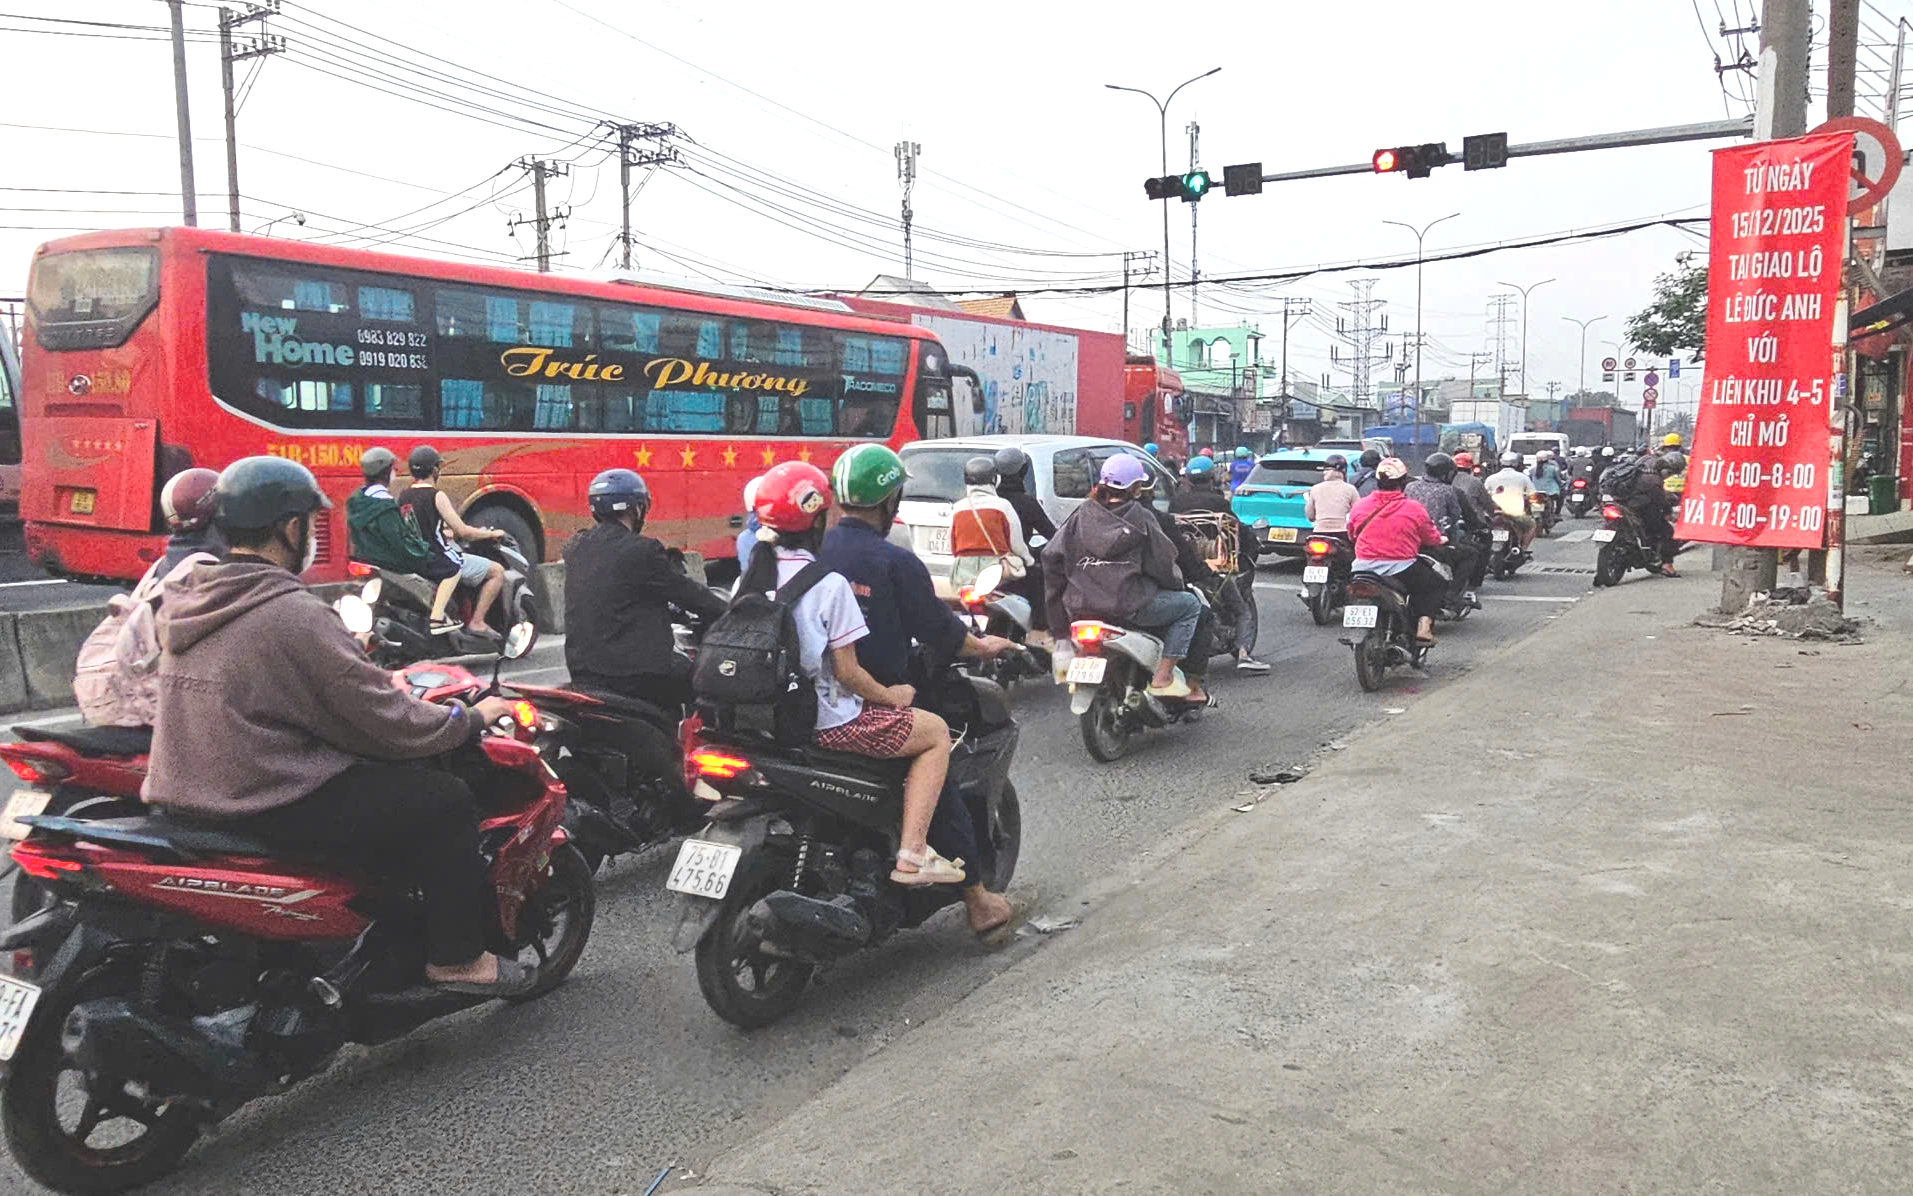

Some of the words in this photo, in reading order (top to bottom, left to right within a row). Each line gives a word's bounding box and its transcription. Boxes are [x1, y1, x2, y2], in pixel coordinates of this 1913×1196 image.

[1744, 162, 1763, 195] TỪ
[1766, 157, 1815, 191] NGÀY
[1731, 205, 1825, 239] 15/12/2025
[1729, 254, 1749, 286] TẠI
[1751, 252, 1792, 279] GIAO
[1798, 244, 1823, 283] LỘ
[1725, 292, 1743, 323] LÊ
[1744, 290, 1777, 321] ĐỨC
[1781, 294, 1822, 320] ANH
[254, 331, 354, 368] Home
[387, 331, 405, 346] 829
[1748, 331, 1778, 363] VỚI
[359, 351, 385, 367] 0919
[389, 353, 407, 368] 020
[501, 347, 624, 381] Trúc
[644, 357, 811, 397] Phương
[1712, 375, 1742, 404] LIÊN
[1745, 379, 1781, 404] KHU
[1787, 379, 1823, 406] 4-5
[1731, 413, 1755, 446] CHỈ
[1759, 414, 1789, 446] MỞ
[877, 466, 900, 486] Grab
[1702, 456, 1724, 485] TỪ
[1726, 463, 1815, 489] 6:00-8:00
[1684, 493, 1705, 524] VÀ
[1711, 501, 1821, 531] 17:00-19:00
[673, 866, 727, 895] 475.66
